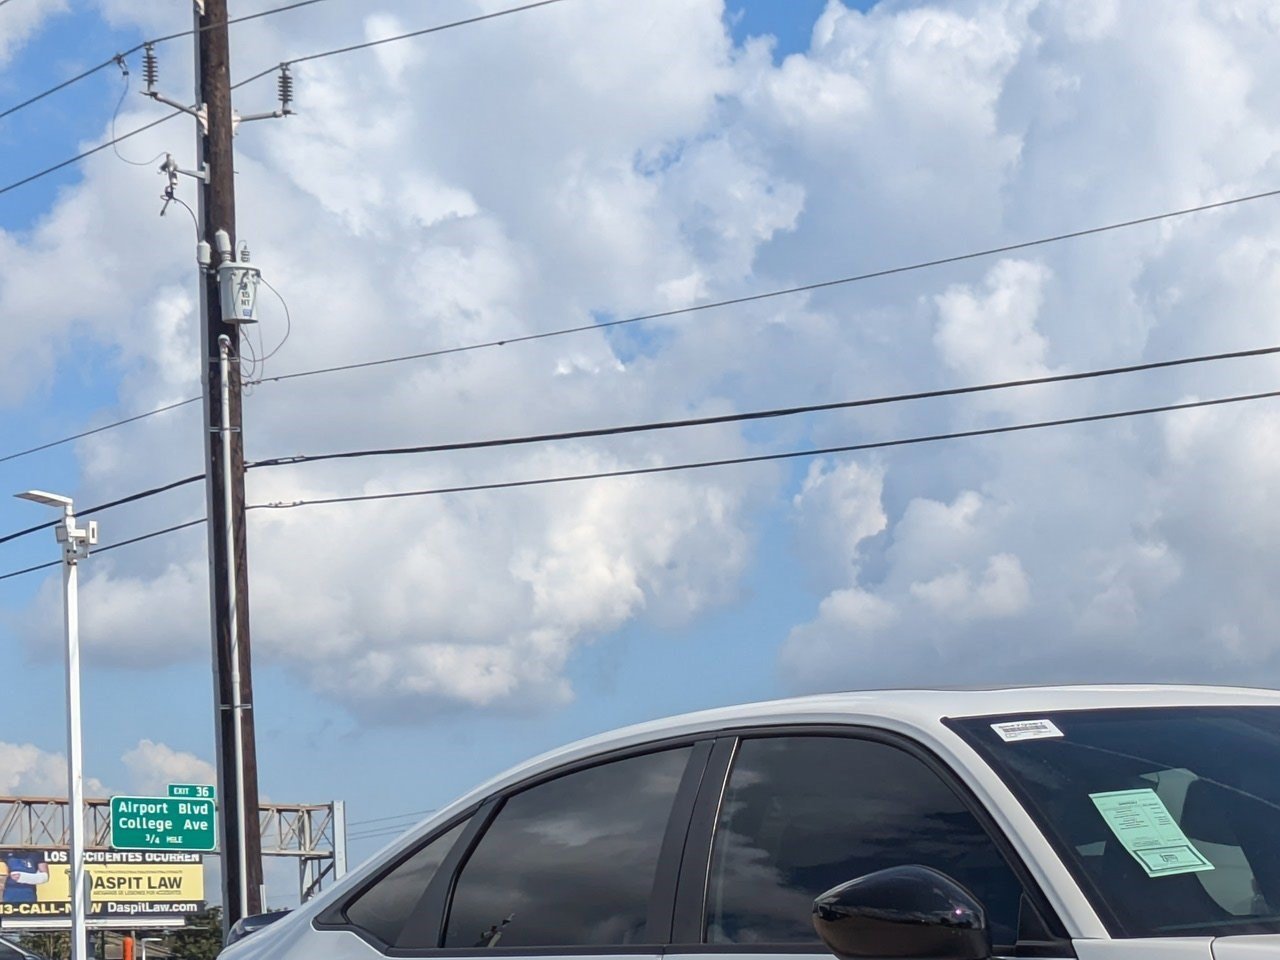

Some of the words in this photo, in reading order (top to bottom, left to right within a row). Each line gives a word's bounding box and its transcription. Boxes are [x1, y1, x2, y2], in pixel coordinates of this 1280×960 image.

[173, 787, 189, 795] EXIT
[196, 787, 209, 797] 36
[118, 801, 168, 816] Airport
[178, 803, 208, 815] Blvd
[119, 817, 173, 832] College
[183, 819, 208, 830] Ave
[145, 834, 160, 844] 3/4
[44, 851, 68, 862] LOS
[82, 852, 143, 862] CIDENTES
[147, 876, 183, 890] LAW
[107, 902, 198, 915] DaspitLaw.com
